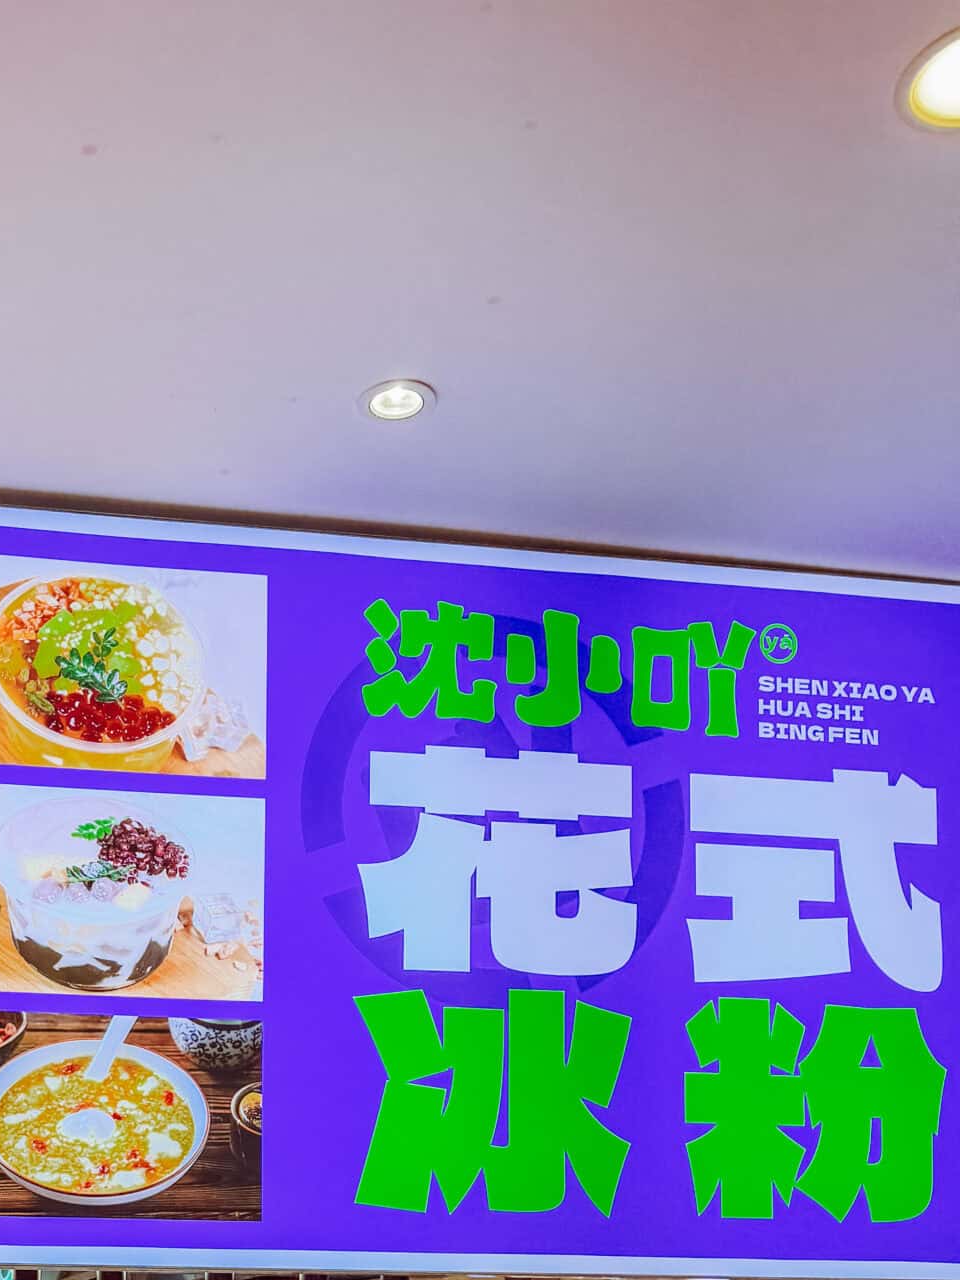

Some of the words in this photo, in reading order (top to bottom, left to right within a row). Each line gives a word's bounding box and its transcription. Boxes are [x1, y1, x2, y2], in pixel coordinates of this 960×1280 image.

[362, 598, 756, 738] 沈小吖
[758, 675, 828, 697] SHEN
[832, 680, 897, 701] XIAO
[901, 685, 936, 704] YA
[758, 698, 812, 718] HUA
[816, 702, 864, 722] SHI
[758, 721, 824, 742] BING
[828, 726, 879, 746] FEN
[356, 744, 943, 993] 花式
[352, 988, 947, 1224] 冰粉
